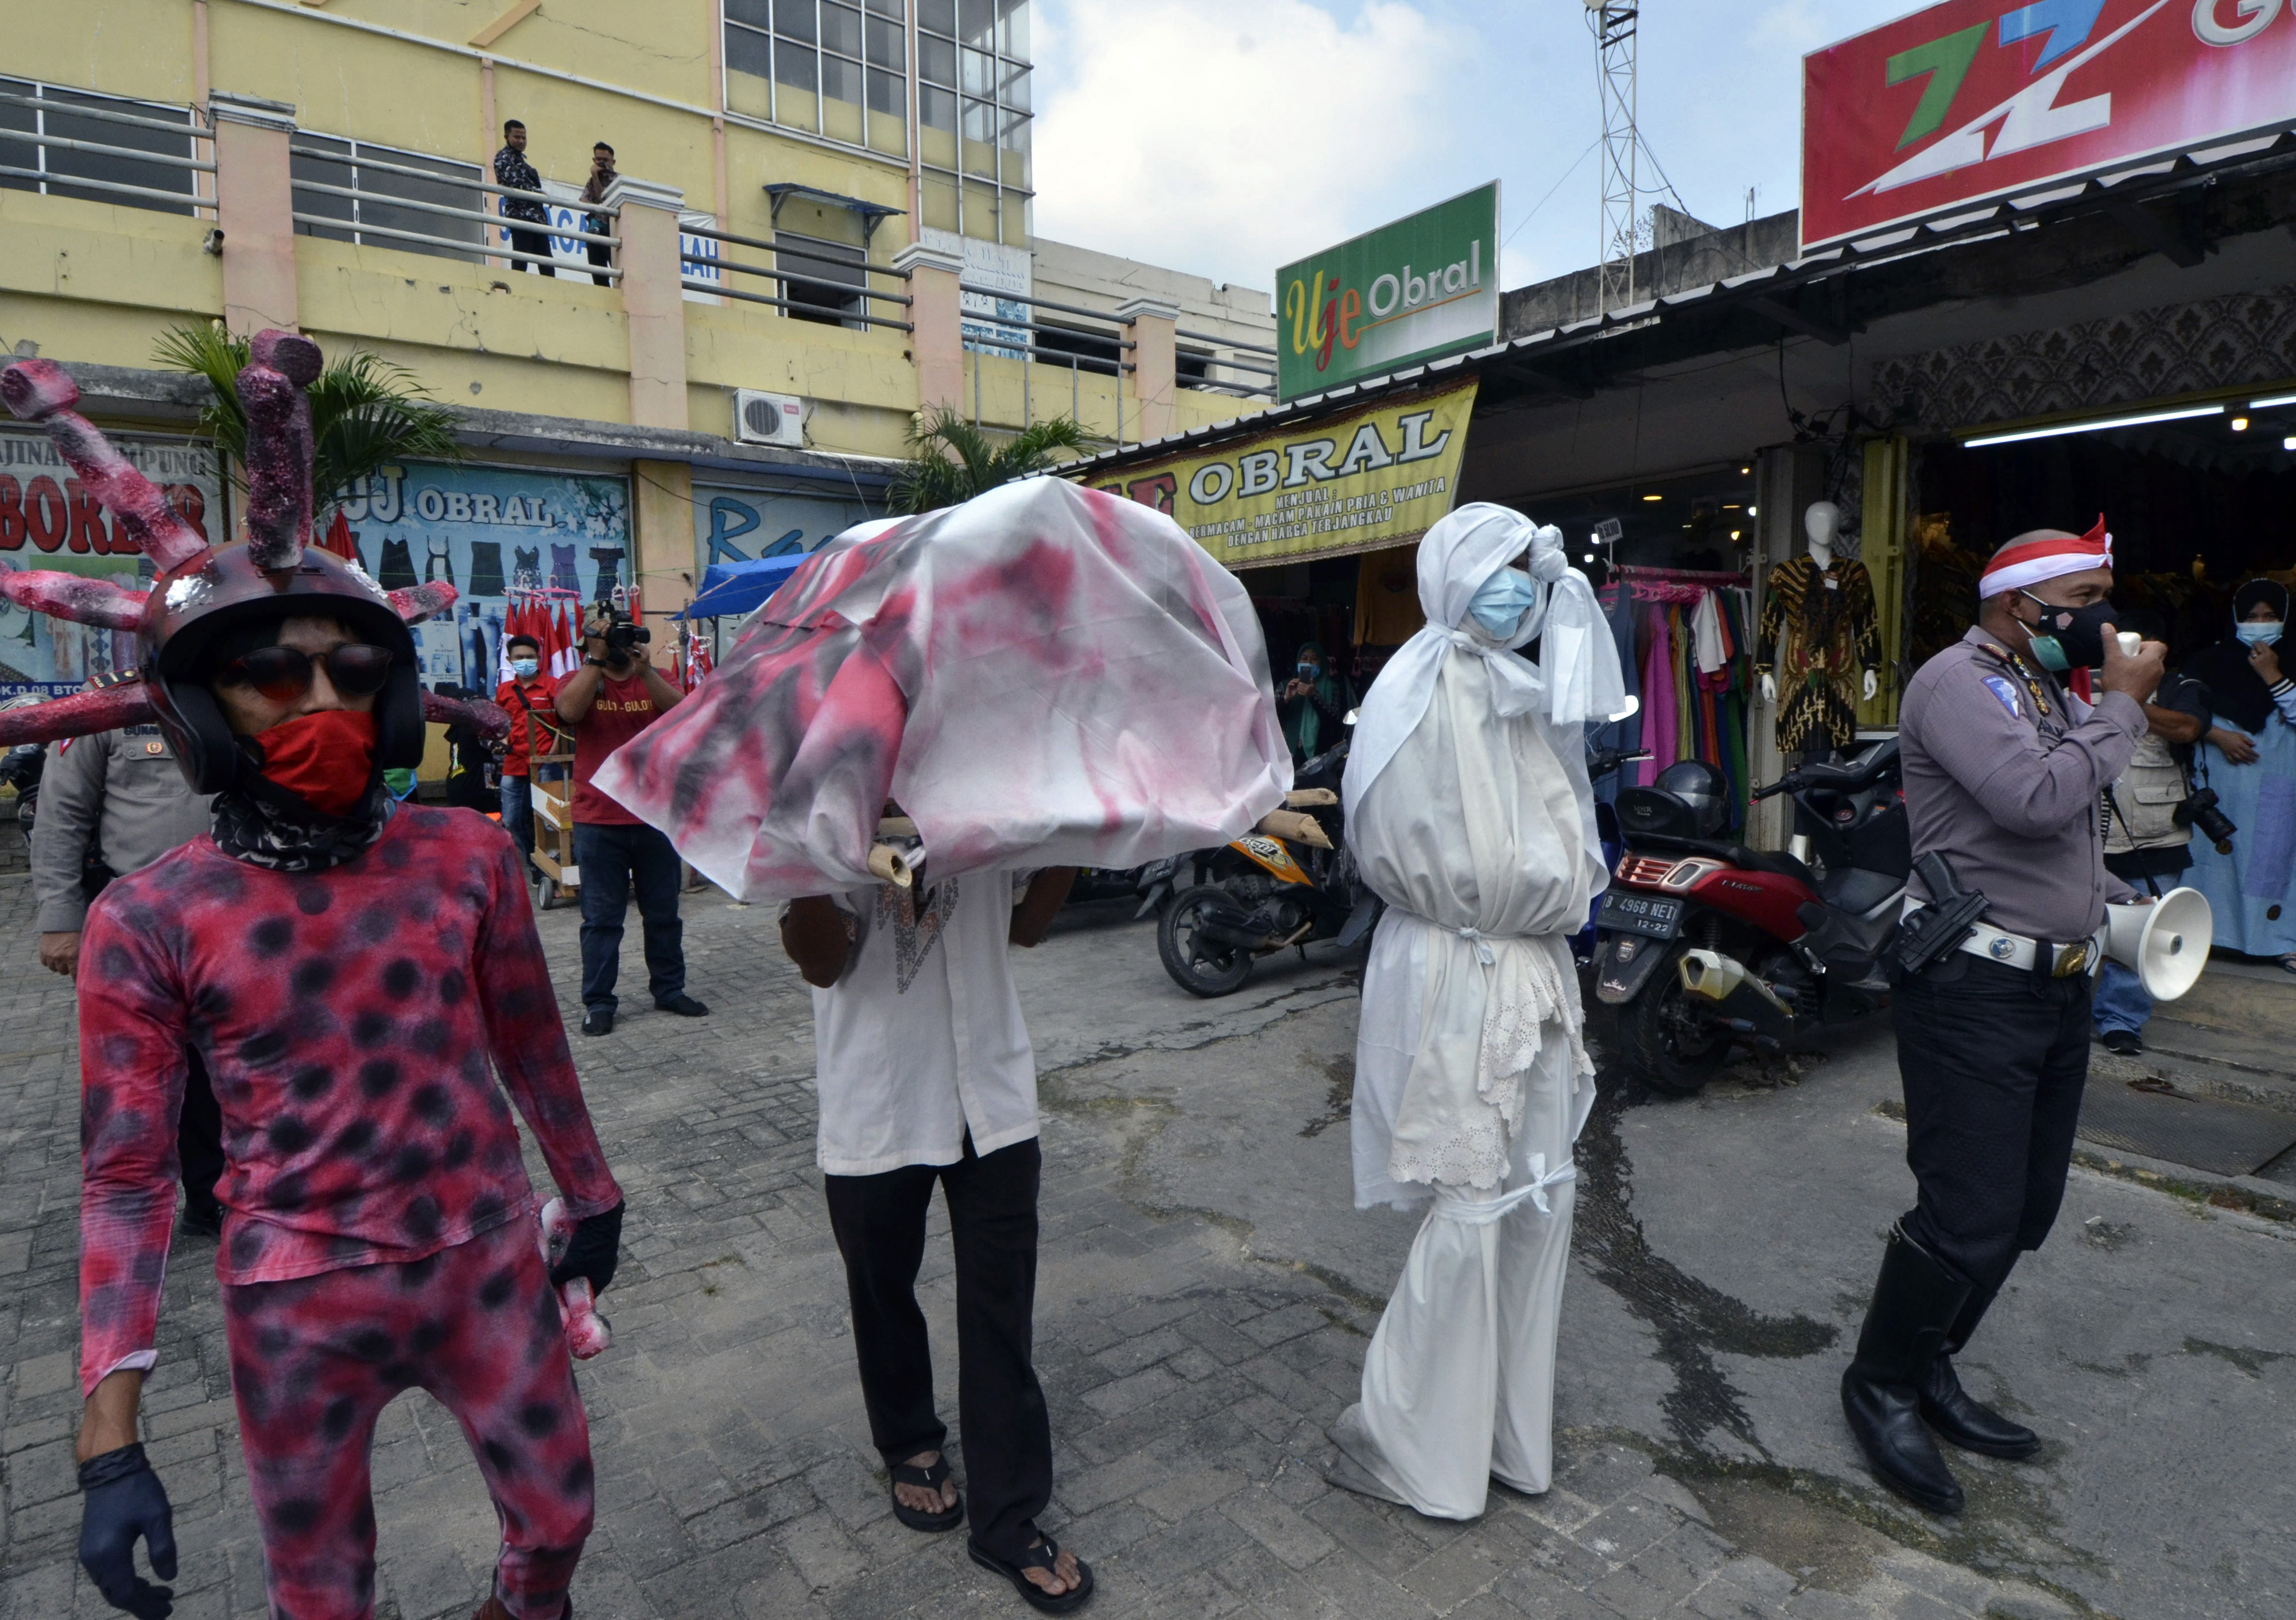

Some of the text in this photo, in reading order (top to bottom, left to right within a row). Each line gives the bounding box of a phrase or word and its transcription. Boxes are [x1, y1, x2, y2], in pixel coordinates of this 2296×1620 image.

[1286, 239, 1480, 372] Uje Obral
[1189, 409, 1453, 505] OBRAL
[416, 487, 556, 528] OBRAL
[1189, 518, 1245, 538] BERMACAM
[1255, 509, 1295, 528] MACAM
[1298, 499, 1343, 521] PAKAIN
[1347, 493, 1376, 512] PRIA
[1379, 490, 1389, 506] &
[1392, 476, 1446, 503] WANITA
[1275, 487, 1329, 510] MENJUAL
[1228, 506, 1393, 547] DENGAN HARGA TERJANGKAU
